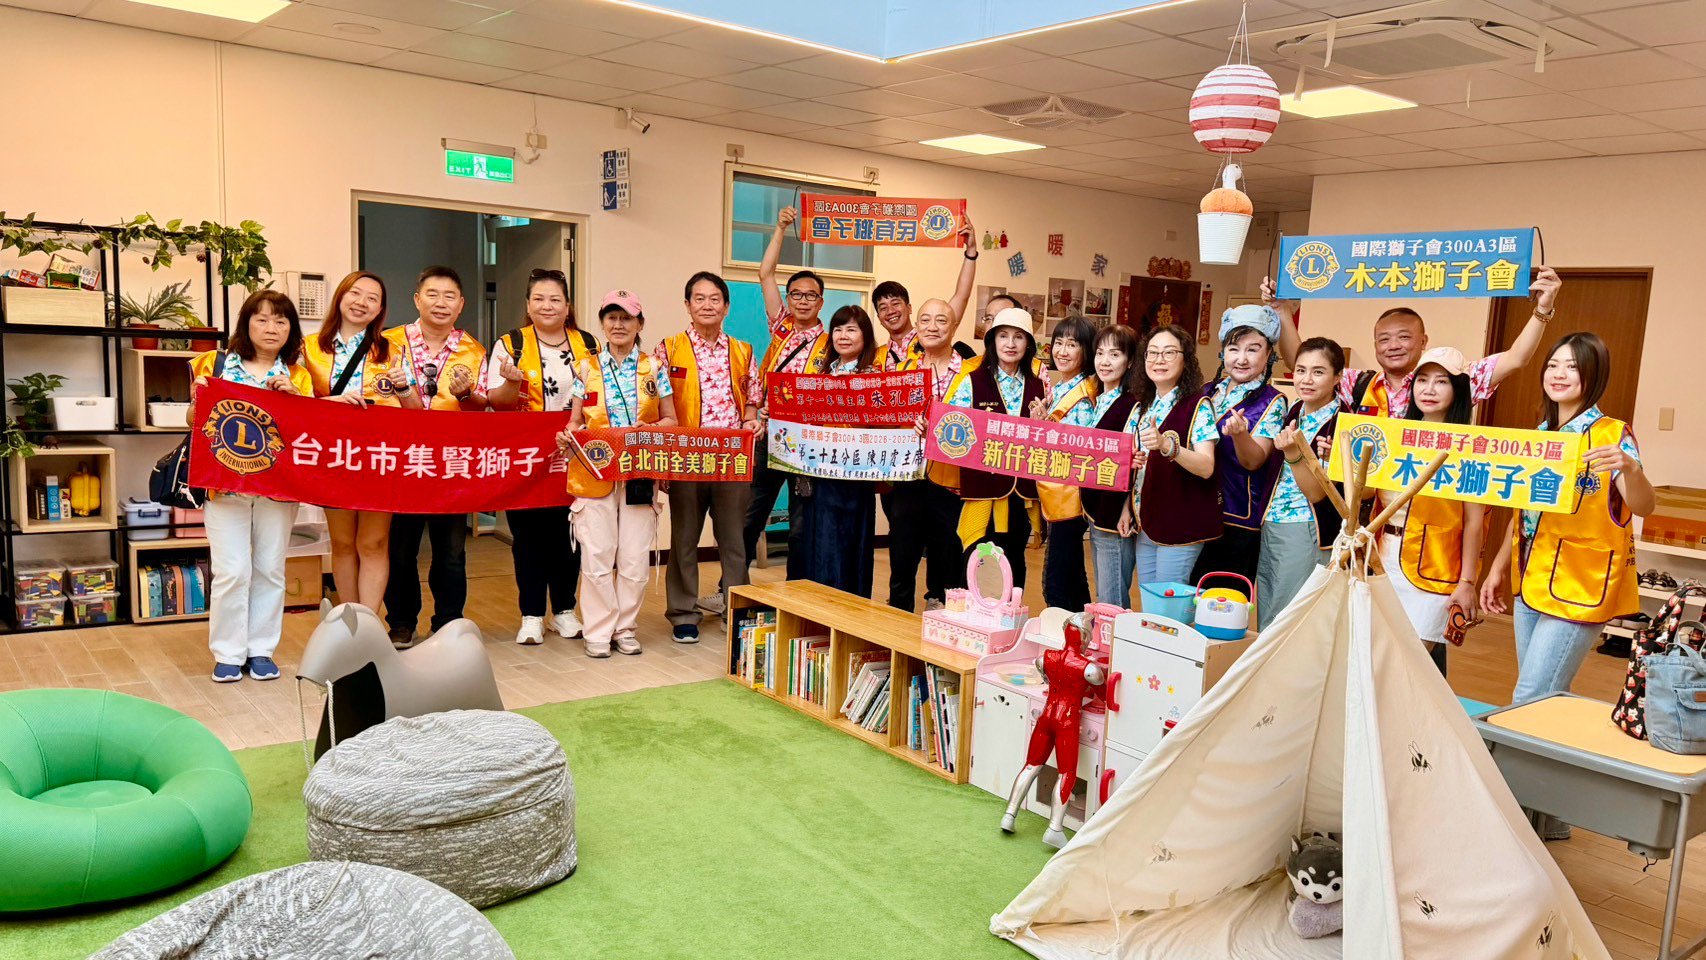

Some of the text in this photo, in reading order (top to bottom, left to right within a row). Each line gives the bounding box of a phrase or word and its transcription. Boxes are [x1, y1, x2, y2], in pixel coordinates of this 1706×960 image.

[449, 166, 471, 175] EXIT
[1351, 236, 1518, 257] 國際獅子會300A3區
[1307, 258, 1320, 275] L
[1344, 259, 1520, 292] 木本獅子會
[224, 402, 268, 424] LIONS
[234, 420, 257, 450] L
[950, 426, 961, 442] L
[987, 419, 1120, 454] 國際獅子會300A3區
[1401, 428, 1564, 461] 國際獅子會300A3區
[219, 451, 268, 470] INTERNATIONAL
[618, 449, 748, 474] 台北市全美獅子會
[983, 439, 1120, 488] 新仟禧獅子會
